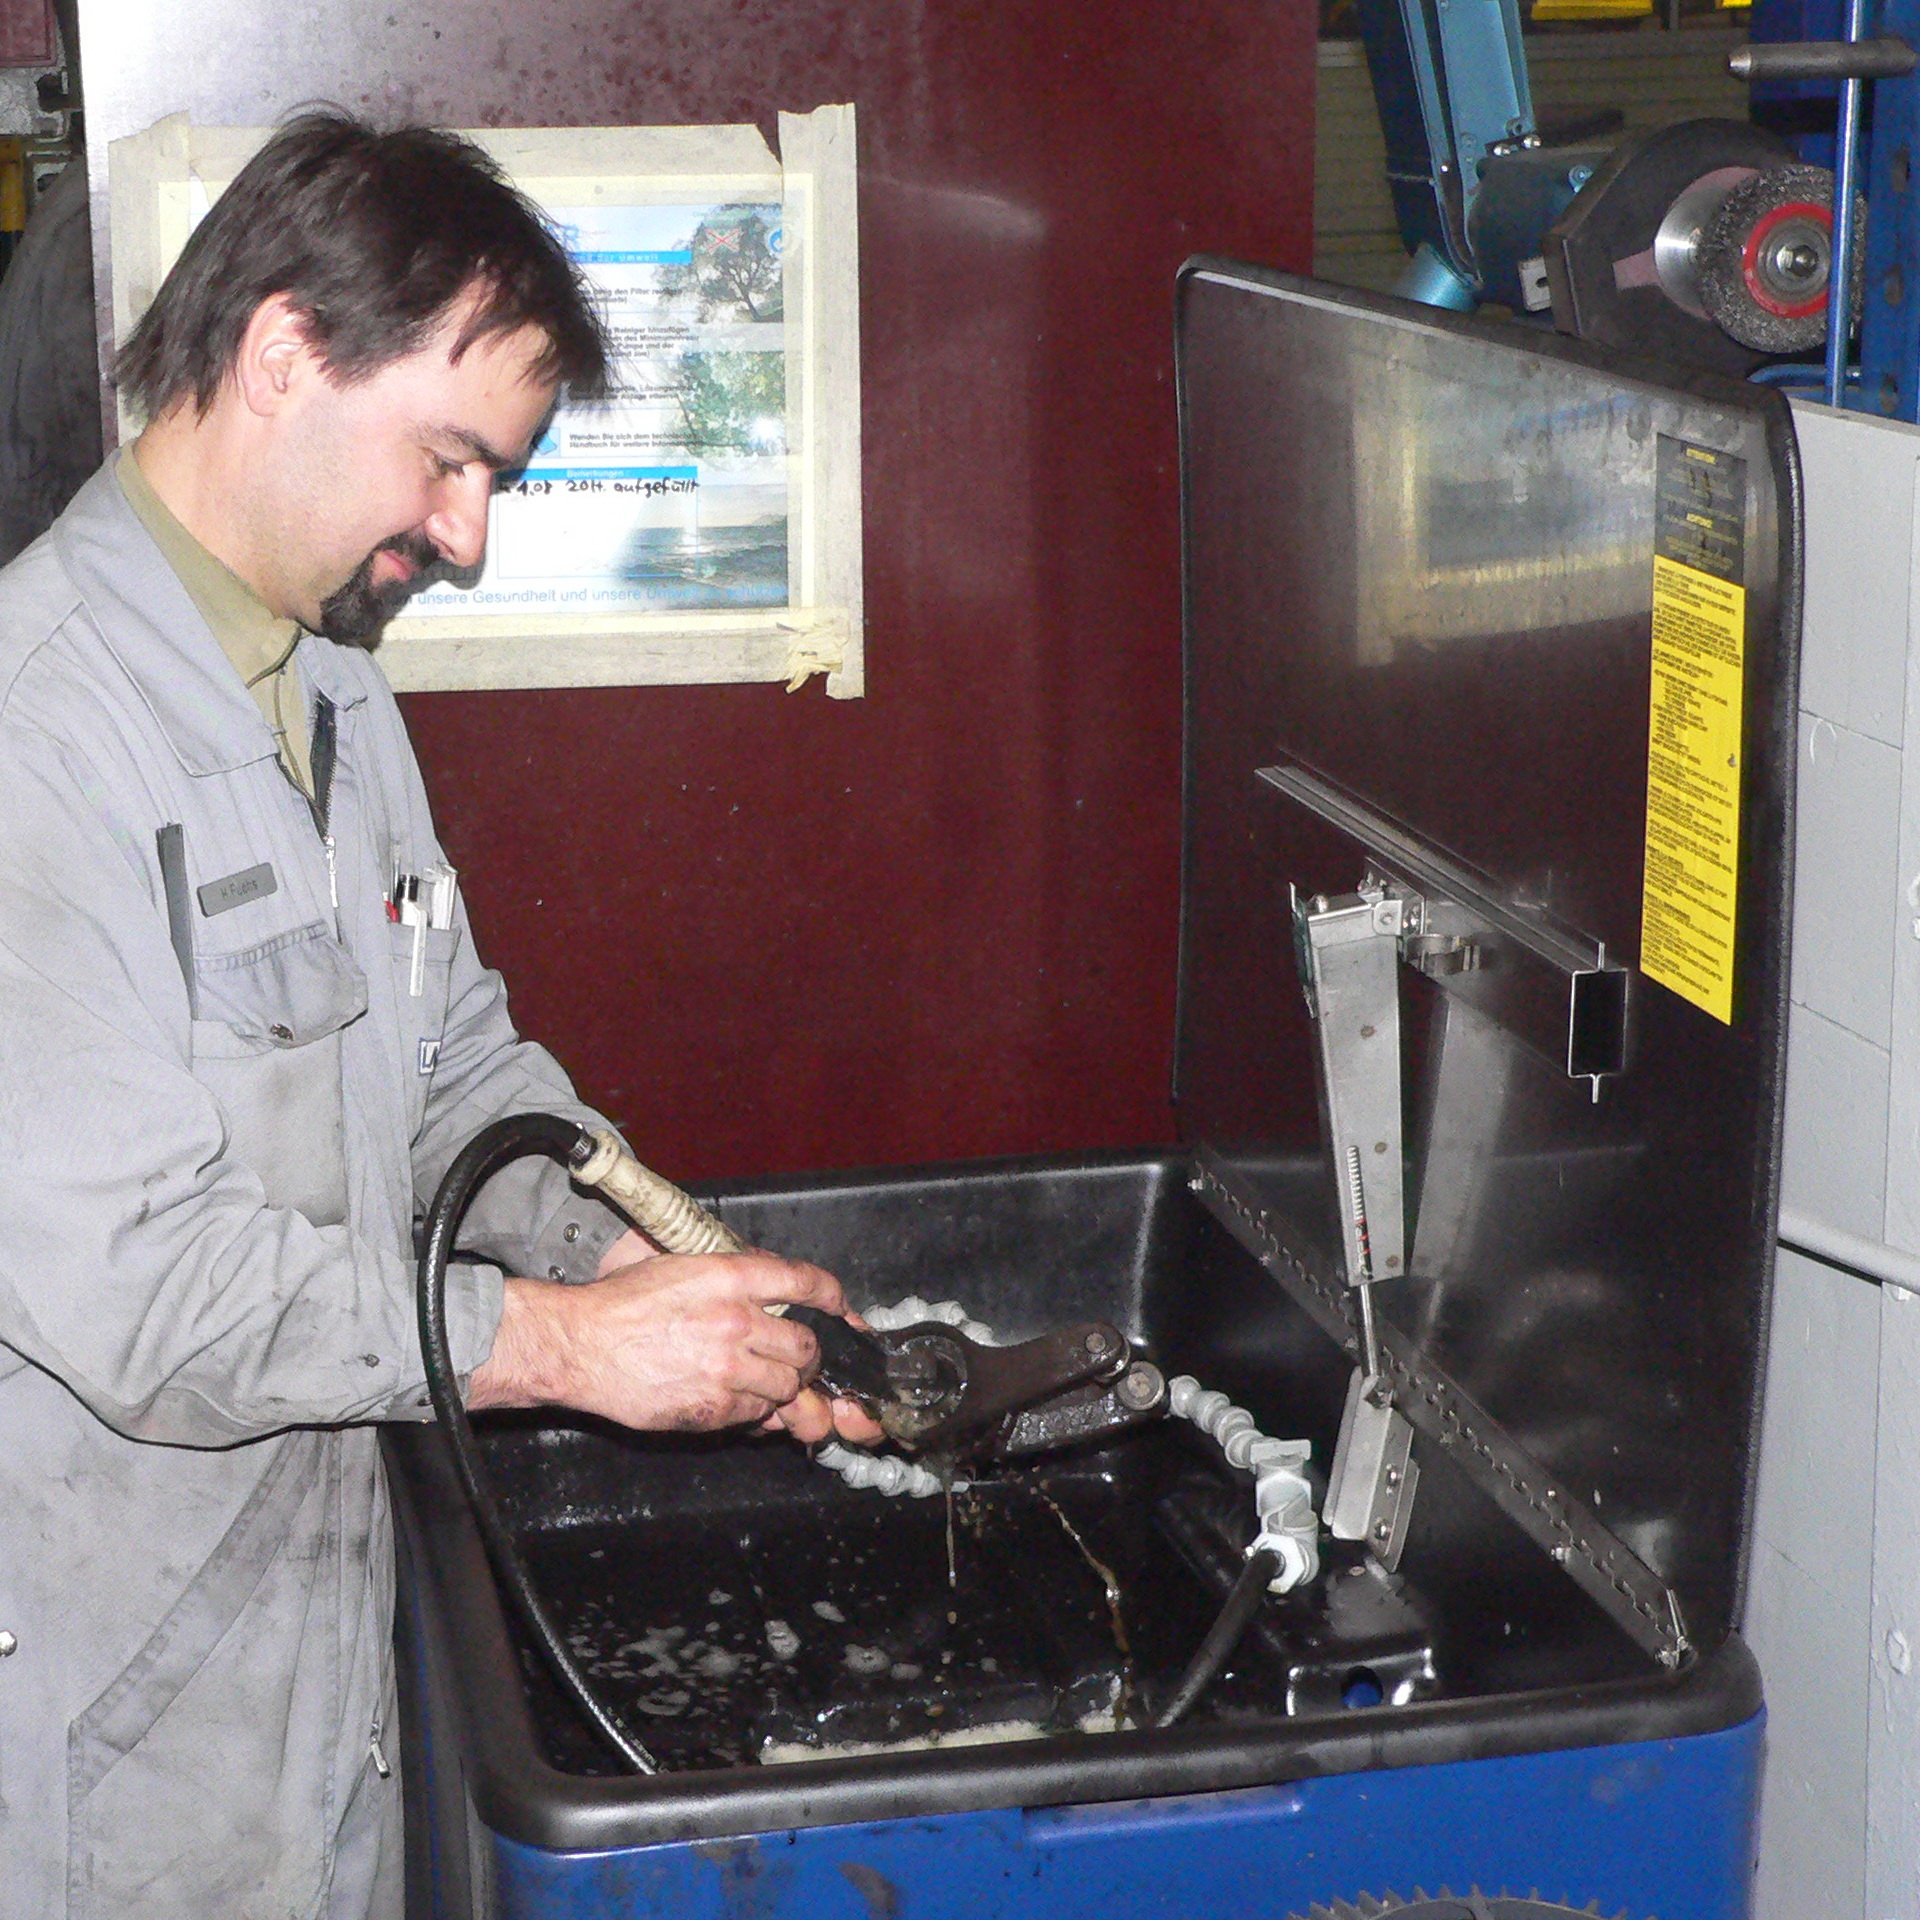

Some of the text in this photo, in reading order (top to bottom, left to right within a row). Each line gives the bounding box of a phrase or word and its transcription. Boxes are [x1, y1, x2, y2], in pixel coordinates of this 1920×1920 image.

[417, 592, 468, 606] unsere
[472, 588, 556, 604] Gesundheit
[560, 588, 588, 602] und
[591, 588, 641, 602] unsere
